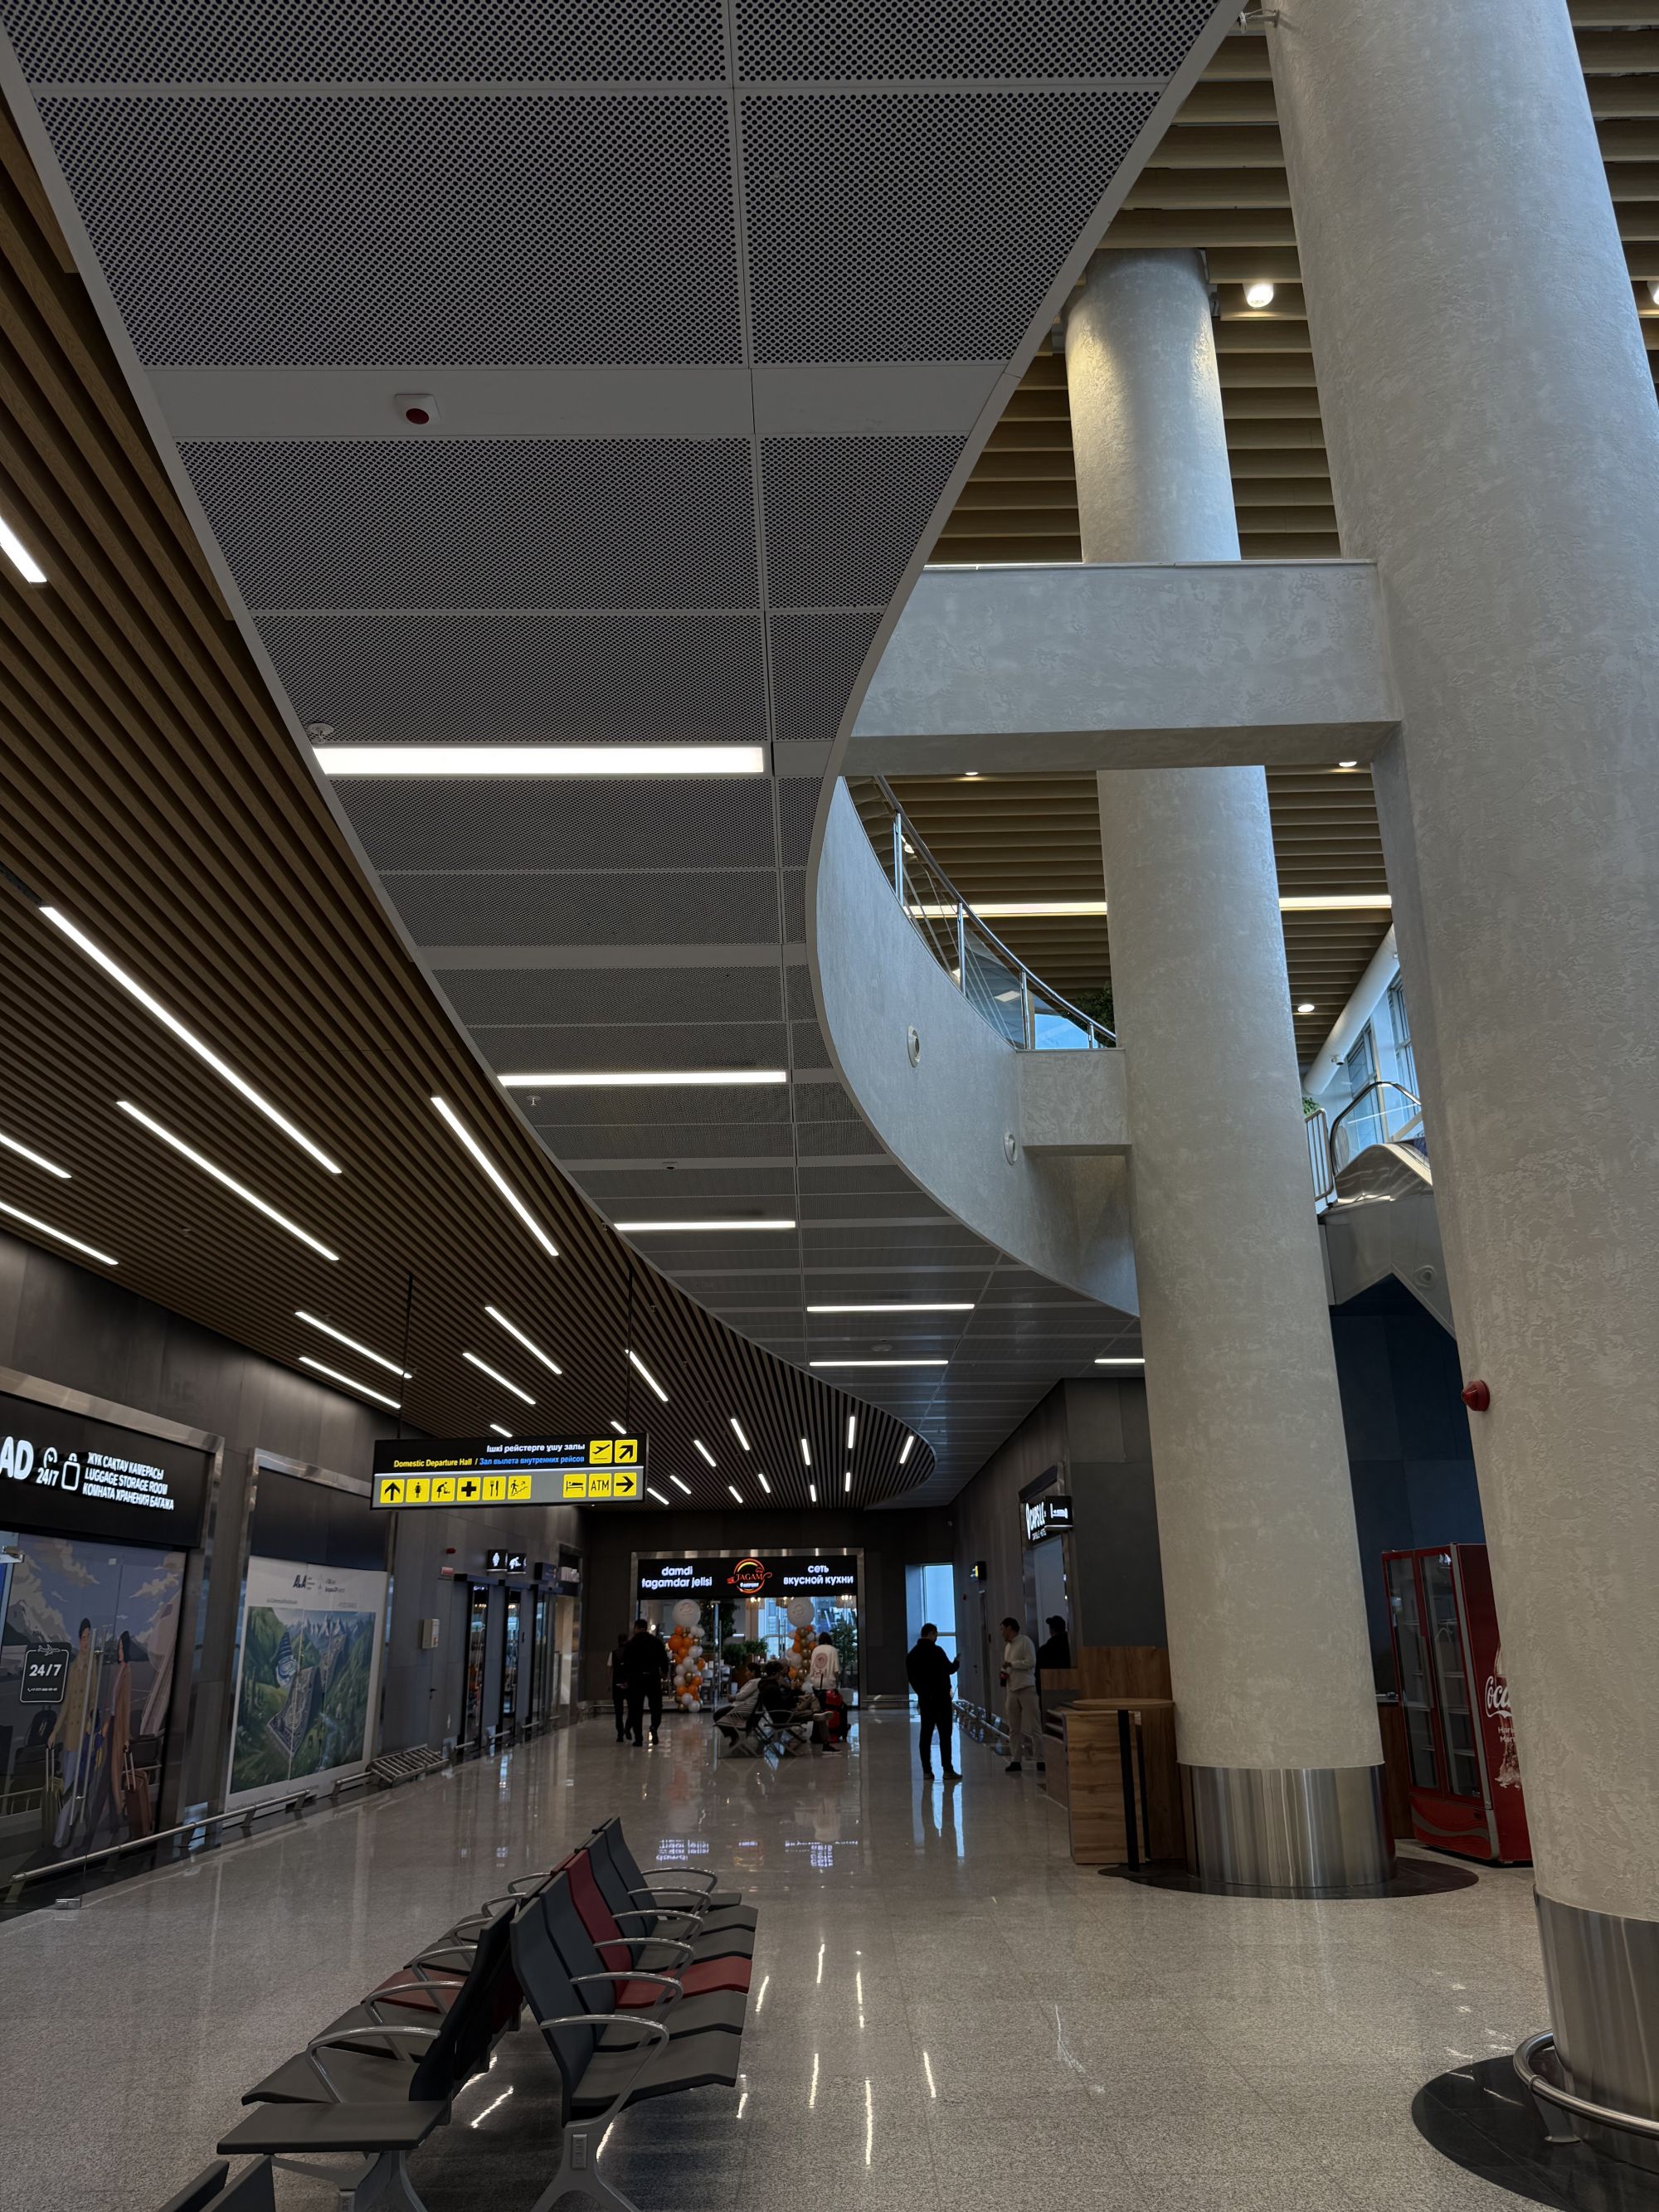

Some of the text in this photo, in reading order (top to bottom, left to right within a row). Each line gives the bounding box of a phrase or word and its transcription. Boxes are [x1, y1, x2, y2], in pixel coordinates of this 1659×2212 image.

[504, 1444, 545, 1453] рейстерге
[393, 1459, 425, 1468] Domestic
[426, 1458, 459, 1468] Departure
[459, 1457, 473, 1466] Hall
[479, 1457, 493, 1466] Зал
[519, 1456, 559, 1466] внутренних
[560, 1455, 585, 1465] рейсов
[129, 1461, 164, 1480] КАМЕРАСЫ
[36, 1467, 60, 1487] 24/7
[84, 1466, 168, 1495] LUGGAGE STORAGE ROOM
[590, 1479, 610, 1491] ATM
[82, 1482, 175, 1510] КОМНАТА ХРАНЕНИЯ БАГАЖА
[661, 1565, 693, 1577] damdi
[807, 1564, 830, 1573] сеть
[641, 1576, 713, 1591] tagamdar jelisi
[783, 1575, 854, 1587] вкусной кухни
[28, 1663, 62, 1677] 24/7
